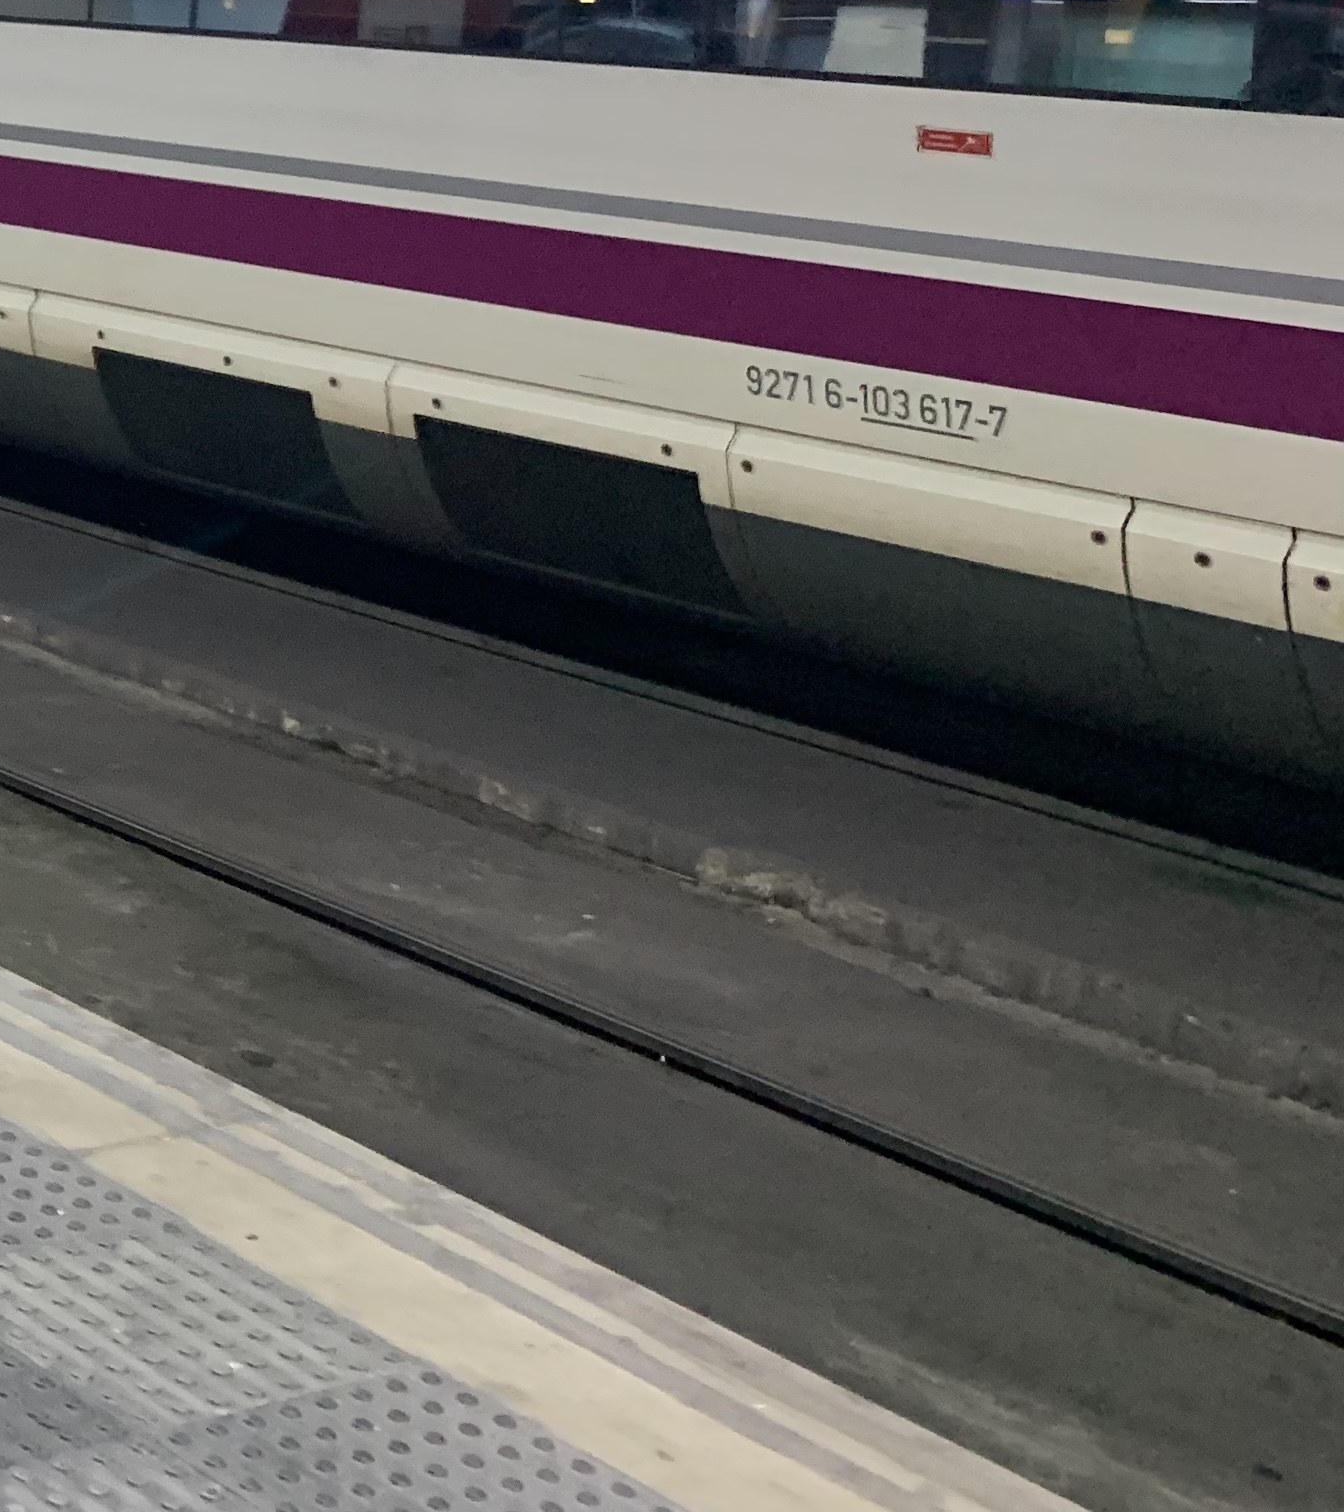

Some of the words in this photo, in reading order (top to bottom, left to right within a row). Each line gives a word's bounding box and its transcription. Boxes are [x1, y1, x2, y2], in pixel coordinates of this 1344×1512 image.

[745, 364, 815, 405] 9271
[824, 378, 910, 421] 6-103
[919, 393, 1008, 438] 617-7
